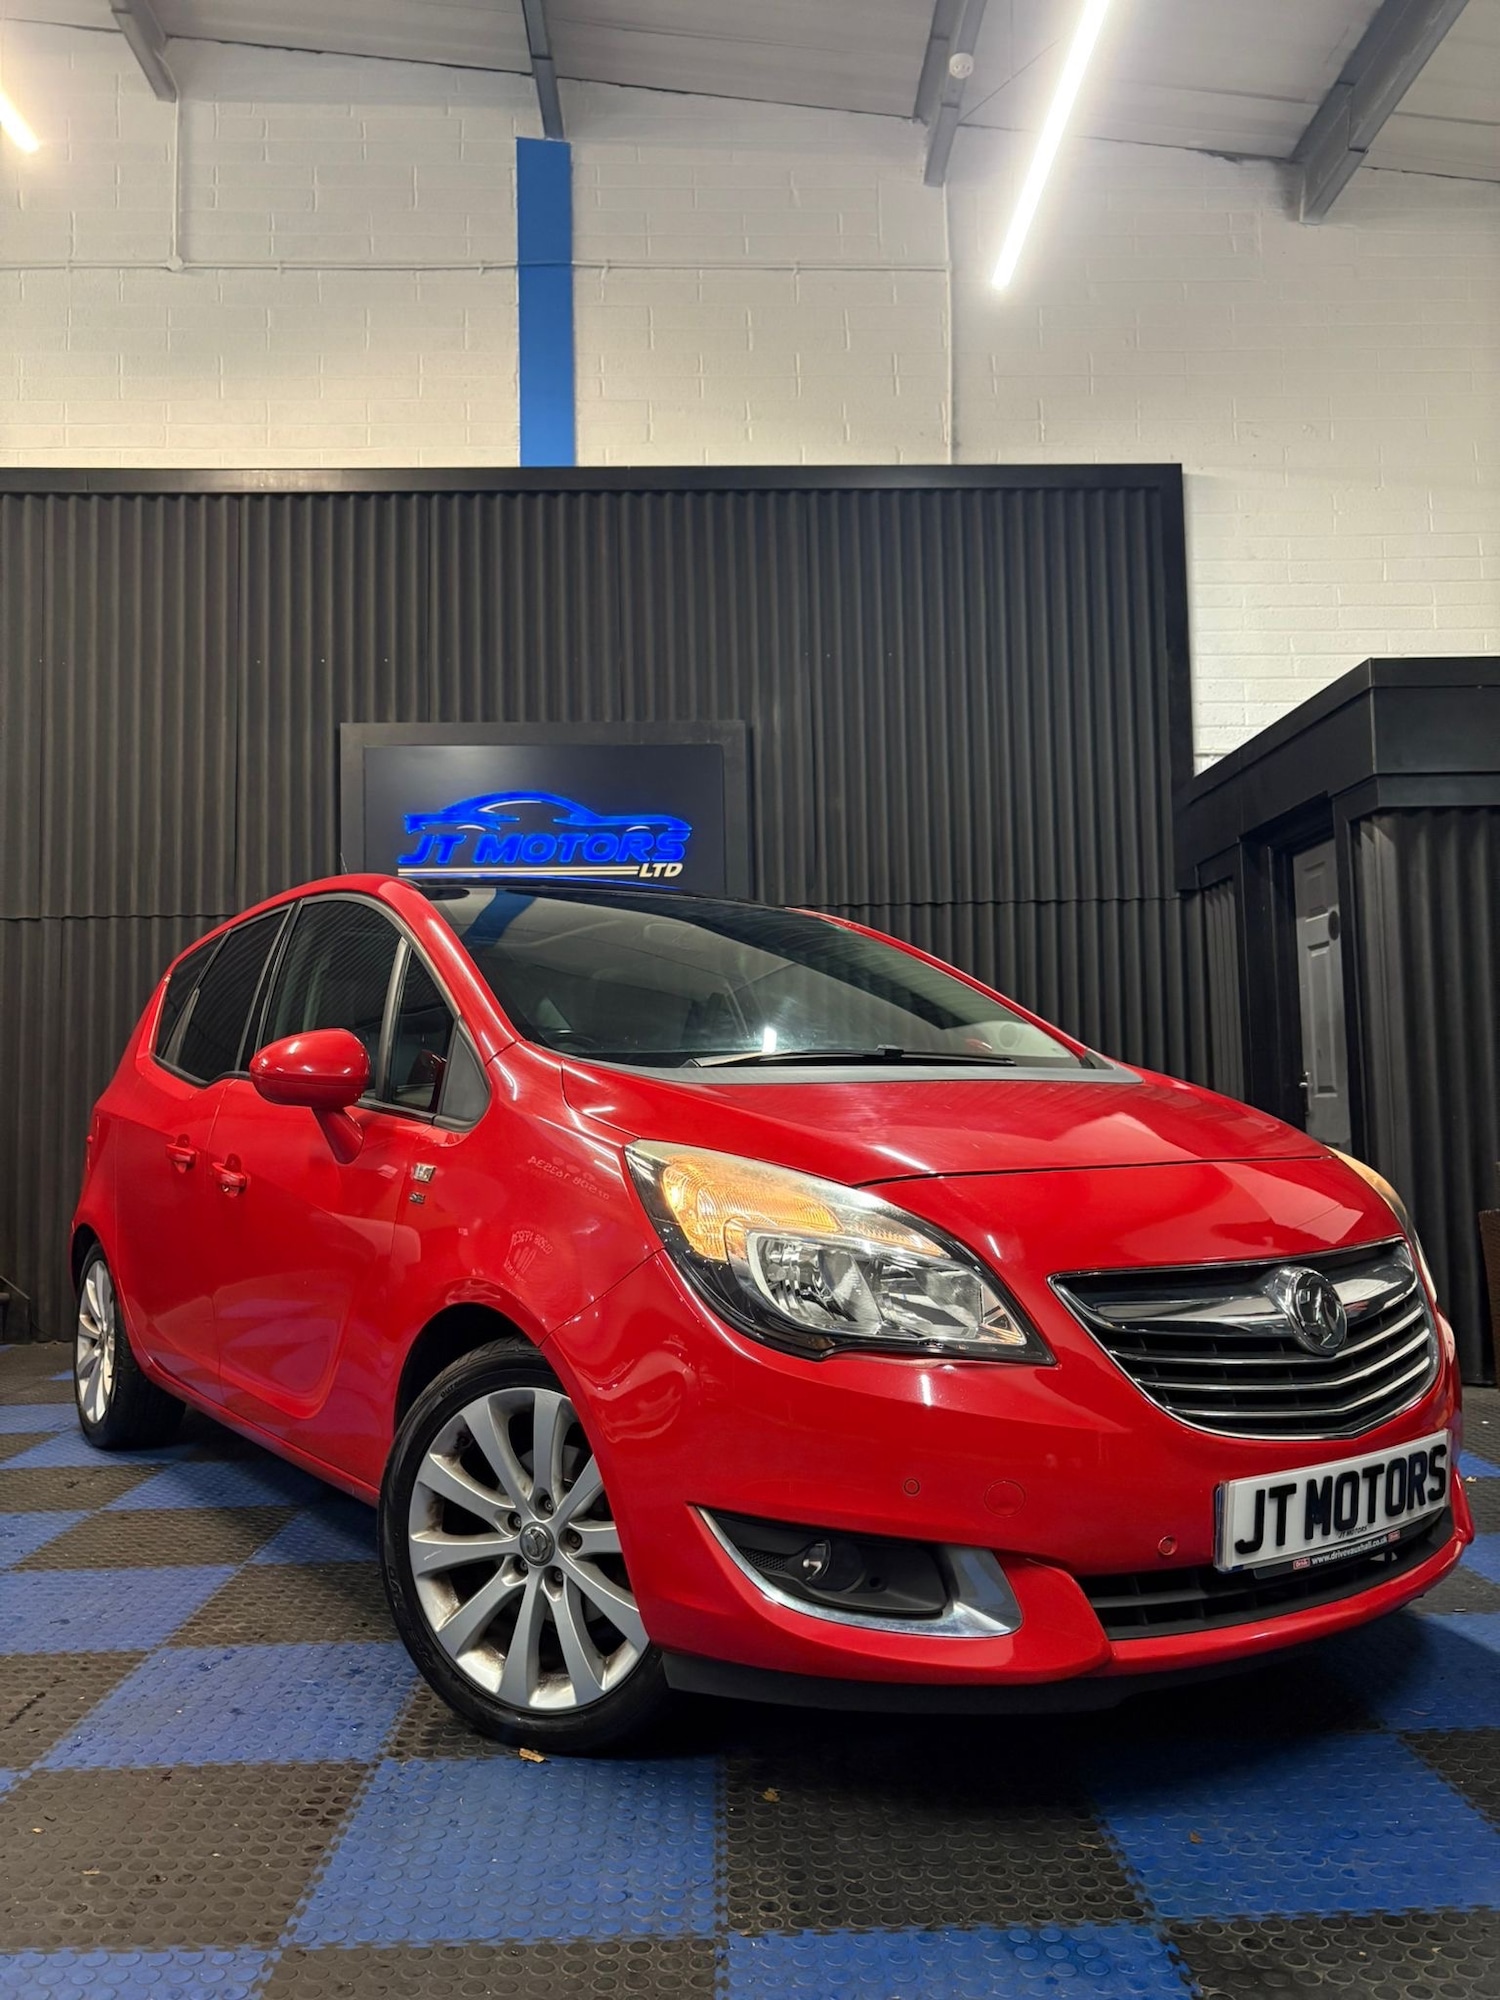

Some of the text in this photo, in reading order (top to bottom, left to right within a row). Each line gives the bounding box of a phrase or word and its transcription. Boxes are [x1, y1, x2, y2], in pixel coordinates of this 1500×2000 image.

[397, 831, 691, 865] JT MOTORS
[638, 862, 684, 879] LTD
[1234, 1443, 1448, 1555] JT MOTORS
[1311, 1536, 1388, 1565] www.drivevauxhall.co.uk
